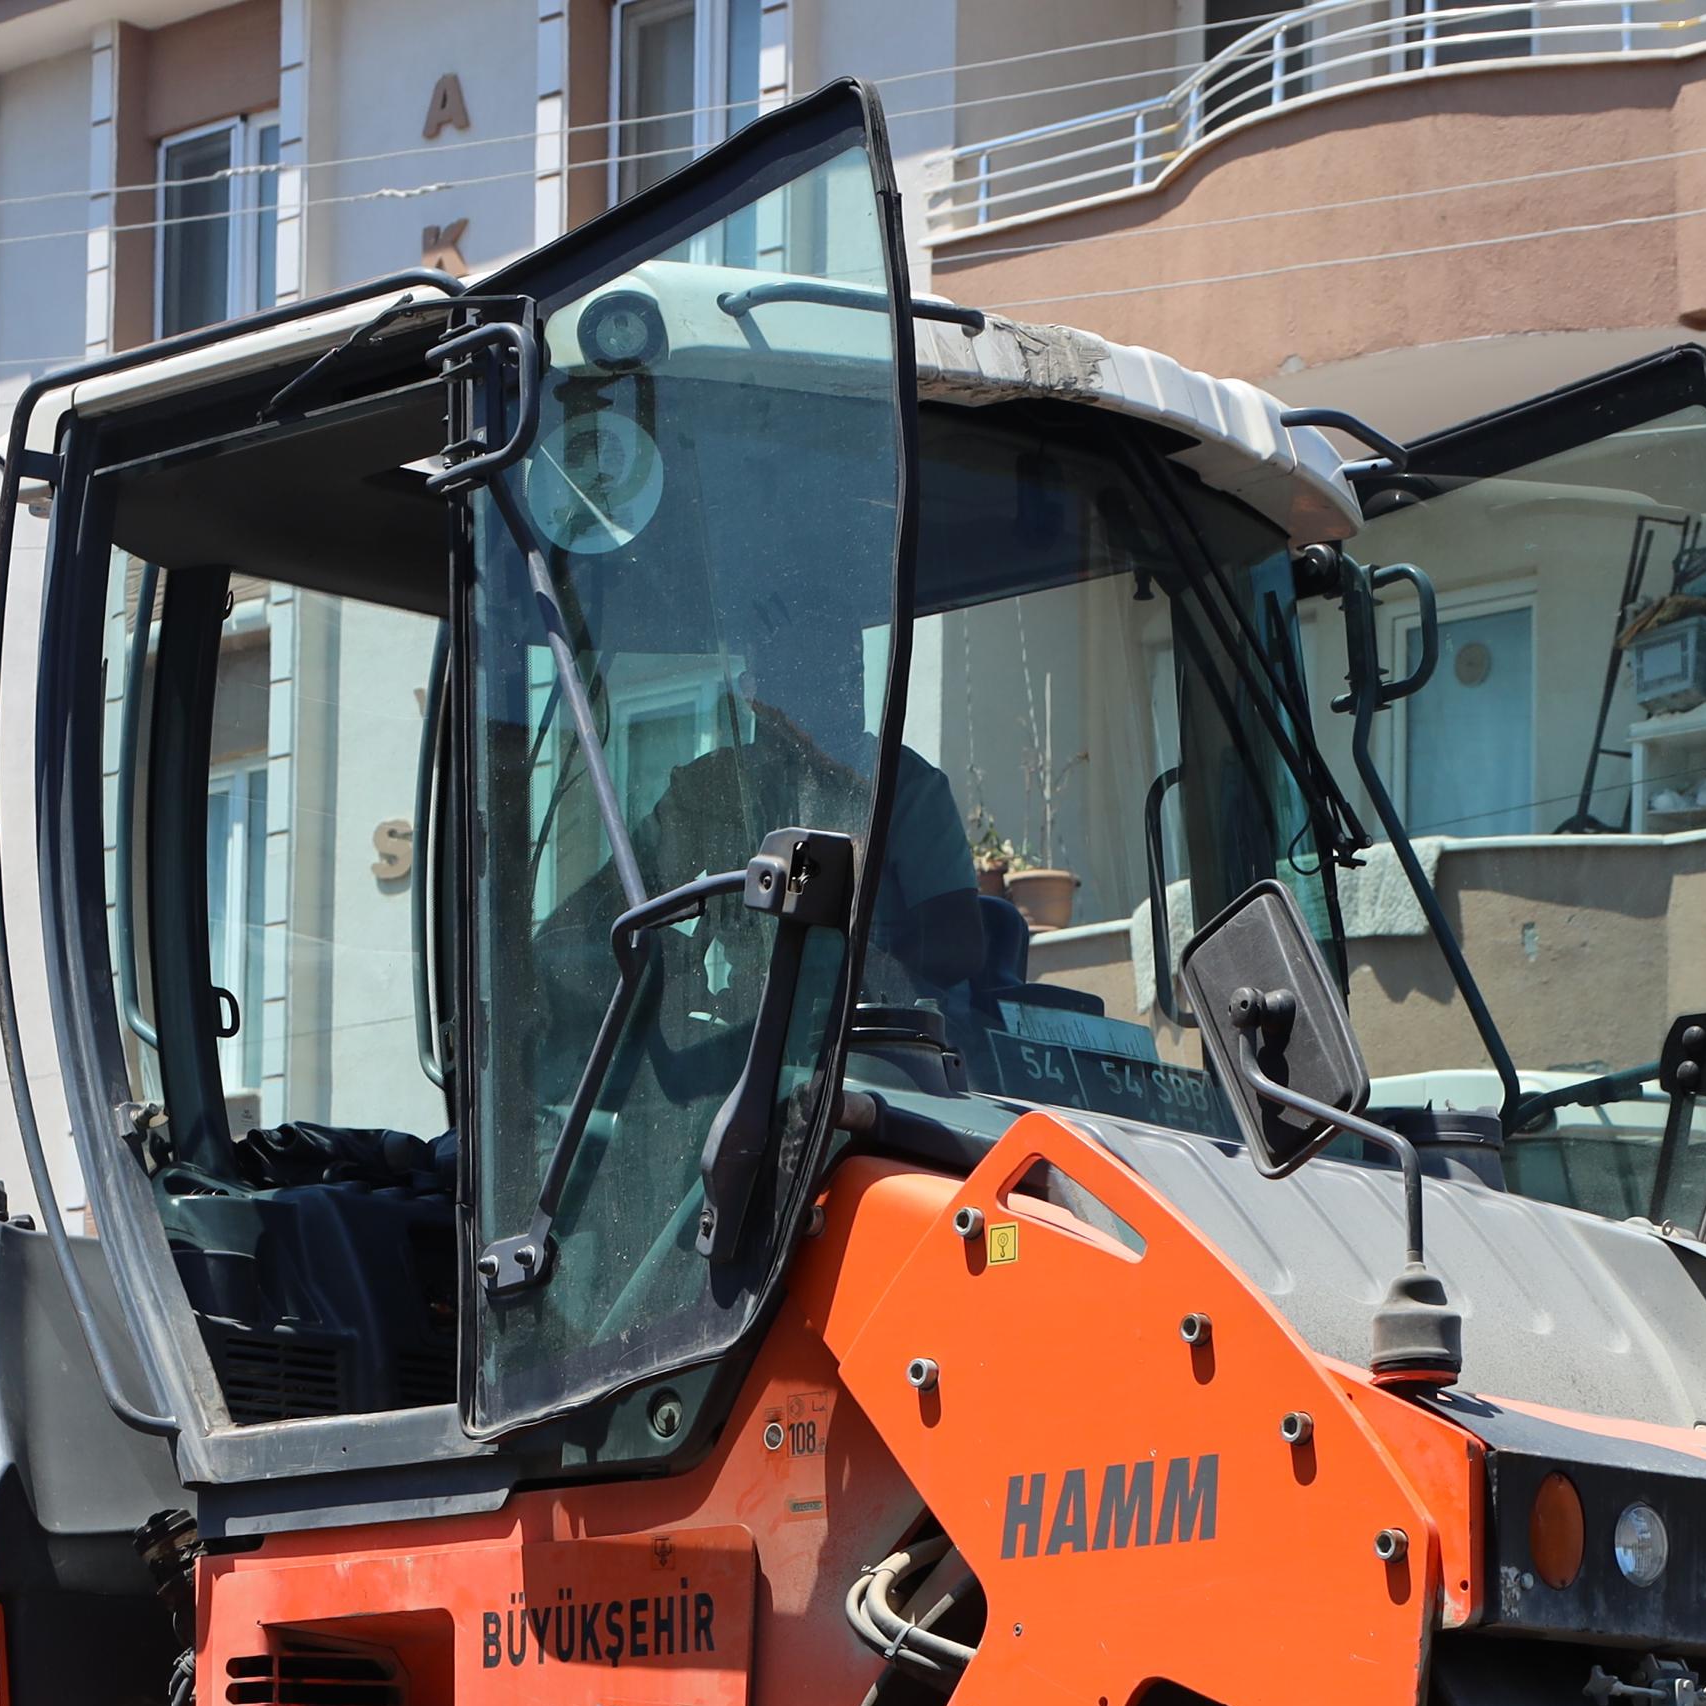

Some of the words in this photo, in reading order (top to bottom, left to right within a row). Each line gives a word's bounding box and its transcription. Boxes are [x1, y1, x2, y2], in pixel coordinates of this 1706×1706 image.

[788, 1419, 817, 1456] 108
[1000, 1453, 1220, 1560] HAMM
[482, 1576, 715, 1668] BÜYÜKŞEHİR
